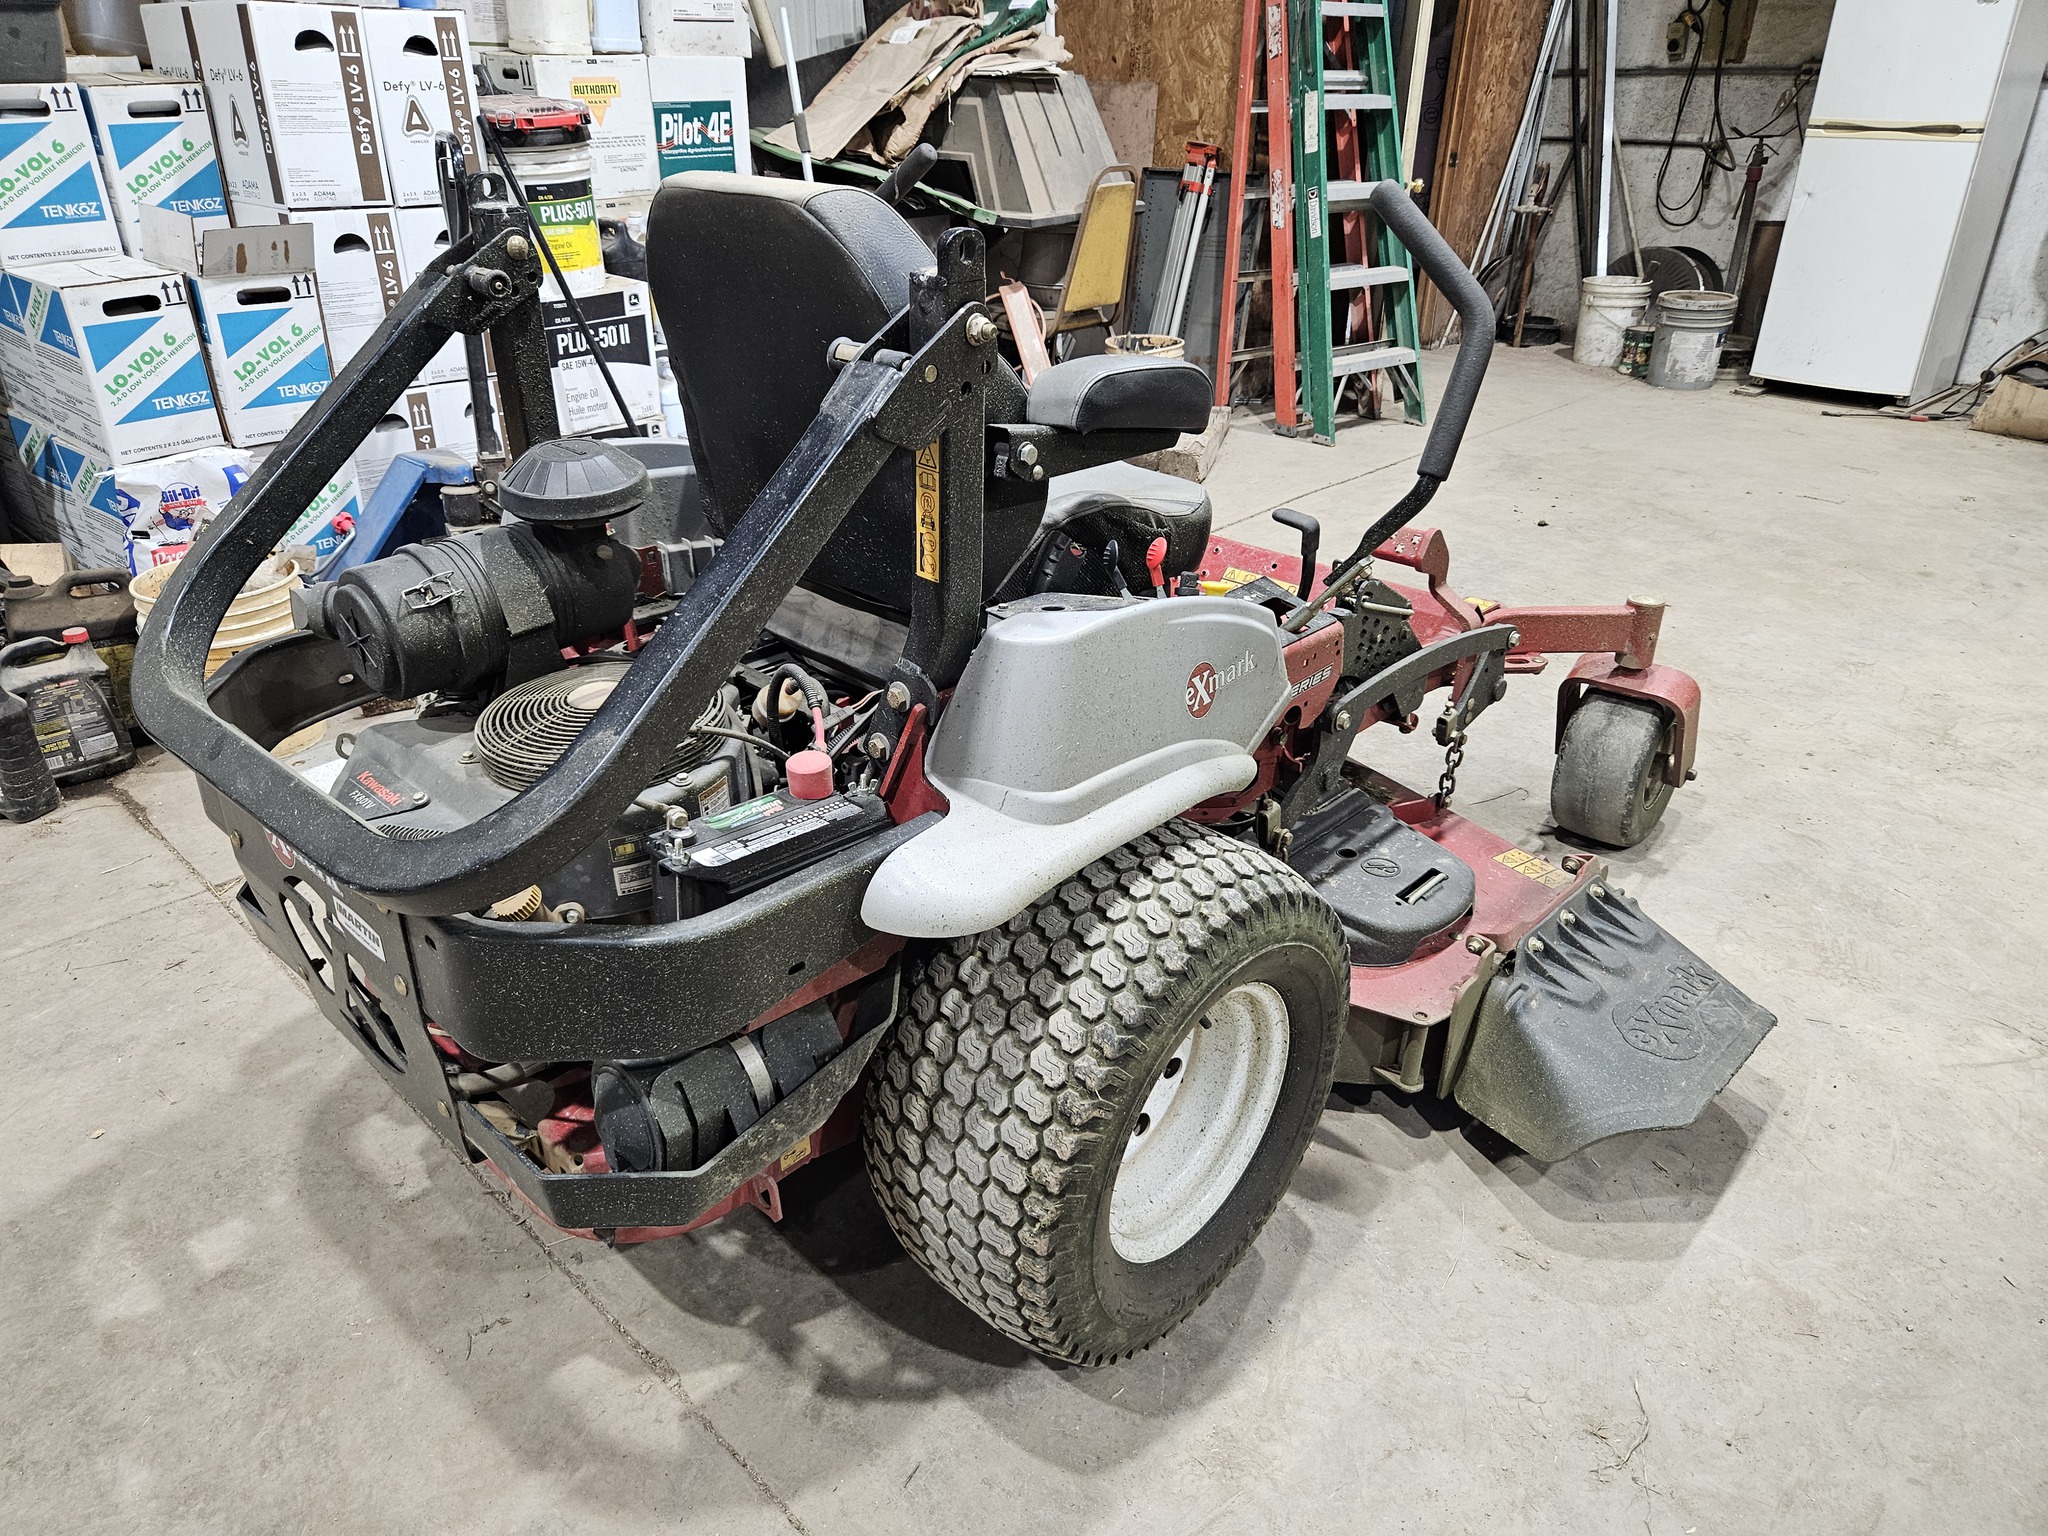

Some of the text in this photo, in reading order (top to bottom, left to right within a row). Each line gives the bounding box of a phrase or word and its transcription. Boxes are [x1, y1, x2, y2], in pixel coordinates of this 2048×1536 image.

[346, 63, 364, 103] LV-6
[419, 81, 445, 92] LV-6
[448, 68, 466, 105] LV-6
[573, 84, 617, 95] AUTHORITY
[661, 112, 702, 146] Pilot
[707, 111, 731, 144] 4E
[51, 139, 65, 154] 6
[14, 183, 30, 198] LOW
[30, 164, 56, 187] VOLATILE
[56, 141, 86, 167] HERBICIDE
[125, 138, 195, 195] LO-VOL 6
[147, 180, 162, 194] LOW
[161, 162, 186, 183] VOLATILE
[186, 140, 213, 164] HERBICIDE
[540, 201, 587, 223] PLUS-50
[1309, 200, 1319, 235] Davidson
[21, 251, 52, 260] CONTENTS
[382, 260, 399, 295] LV-6
[618, 323, 631, 345] II
[104, 332, 177, 396] LO-VOL 6
[233, 323, 303, 381] LO-VOL 6
[238, 324, 322, 393] 2,4-D LOW VOLATILE HERBICIDE
[561, 361, 573, 371] SAE
[110, 332, 197, 408] 2,4-D LOW VOLATILE HERBICIDE
[566, 388, 599, 404] Engine Oil
[568, 401, 608, 416] Huile moteur
[133, 445, 163, 454] CONTENTS
[181, 437, 205, 445] GALLONS
[256, 430, 284, 438] CONTENTS
[328, 482, 338, 493] 6
[296, 523, 309, 536] LOW
[308, 503, 332, 525] VOLATILE
[331, 480, 353, 504] HERBICIDE
[1291, 664, 1333, 698] ERIES
[357, 770, 406, 807] Kawasaki
[336, 900, 381, 949] MARTIN
